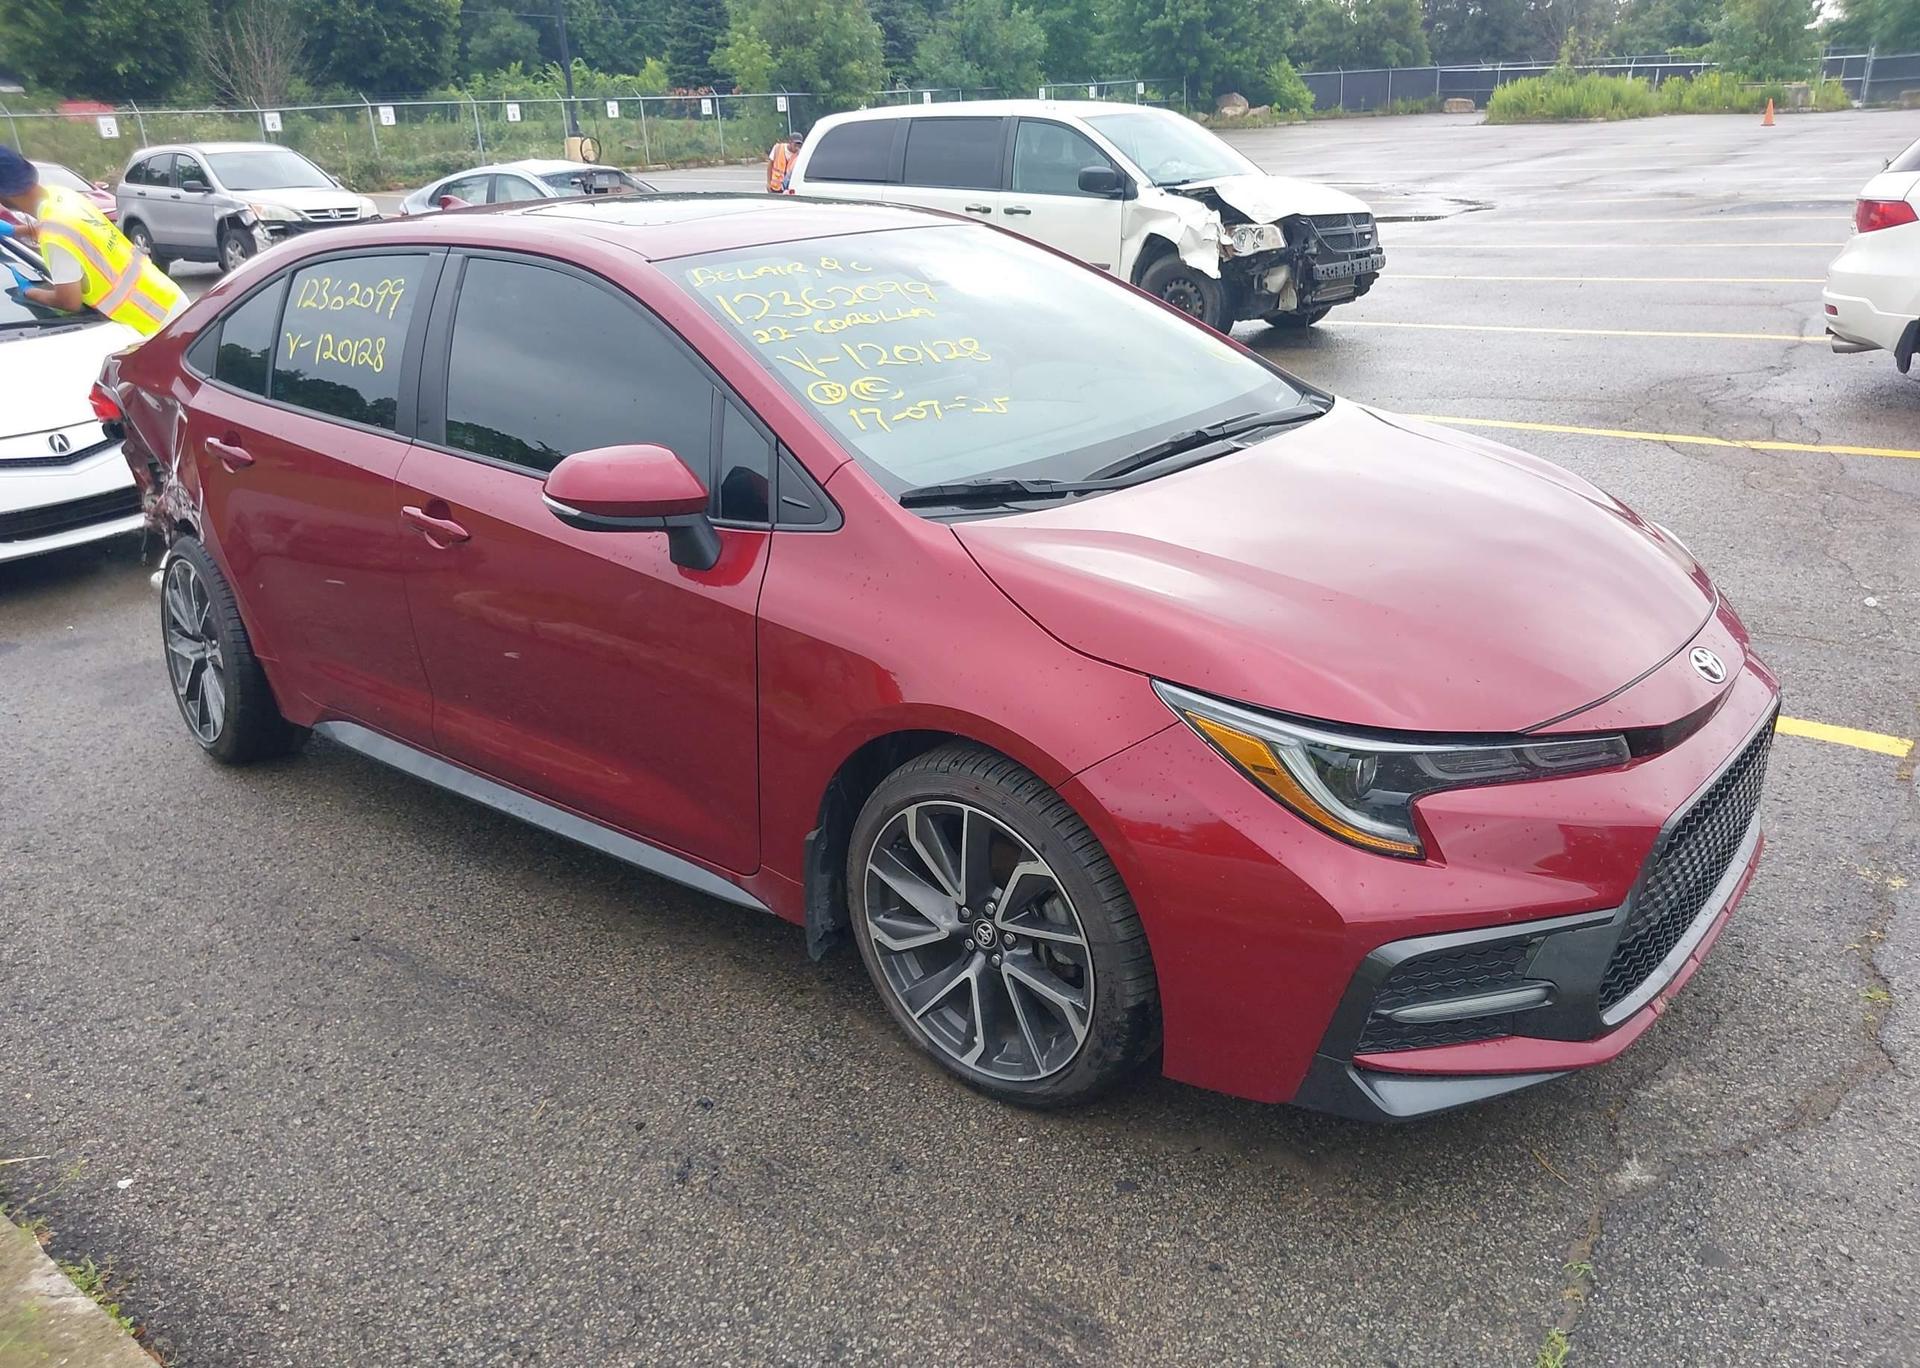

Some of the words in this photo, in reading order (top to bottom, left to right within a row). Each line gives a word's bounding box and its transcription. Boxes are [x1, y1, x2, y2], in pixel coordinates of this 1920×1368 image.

[107, 127, 113, 135] 5
[297, 277, 405, 320] 12362099
[716, 281, 938, 325] 12362099
[776, 338, 992, 377] V-120128
